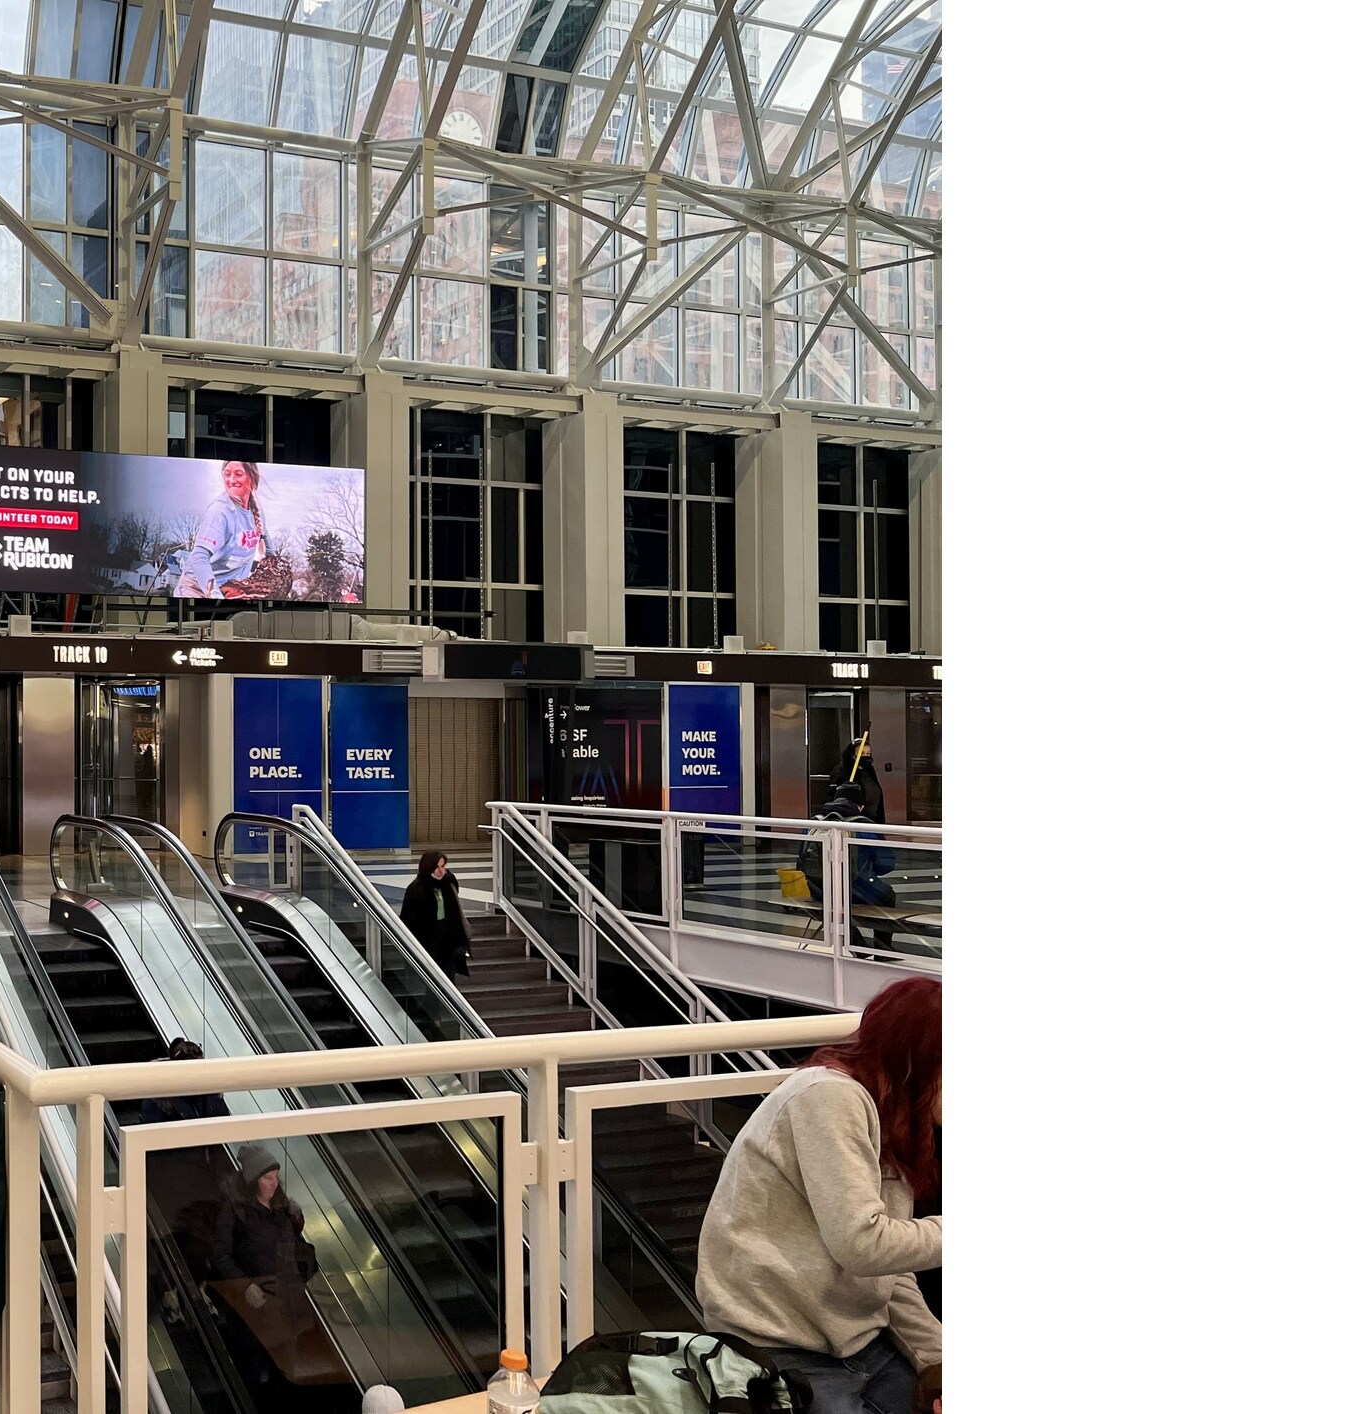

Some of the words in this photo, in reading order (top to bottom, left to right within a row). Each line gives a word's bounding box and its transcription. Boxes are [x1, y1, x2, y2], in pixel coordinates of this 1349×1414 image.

[7, 467, 31, 482] ON
[33, 468, 75, 485] YOUR
[33, 487, 54, 502] TO
[57, 488, 101, 504] HELP.
[40, 513, 74, 526] TODAY
[3, 535, 50, 553] TEAM
[3, 551, 74, 571] RUBICON
[52, 645, 90, 663] TRACK
[94, 646, 108, 664] 10
[271, 651, 286, 661] EXIT
[189, 658, 217, 666] Tickets
[831, 663, 858, 678] TRACK
[860, 663, 869, 678] 11
[681, 731, 716, 742] MAKE
[249, 747, 281, 760] ONE
[346, 748, 393, 760] EVERY
[681, 747, 715, 759] YOUR
[249, 765, 302, 778] PLACE.
[345, 766, 395, 779] TASTE.
[681, 764, 721, 776] MOVE.
